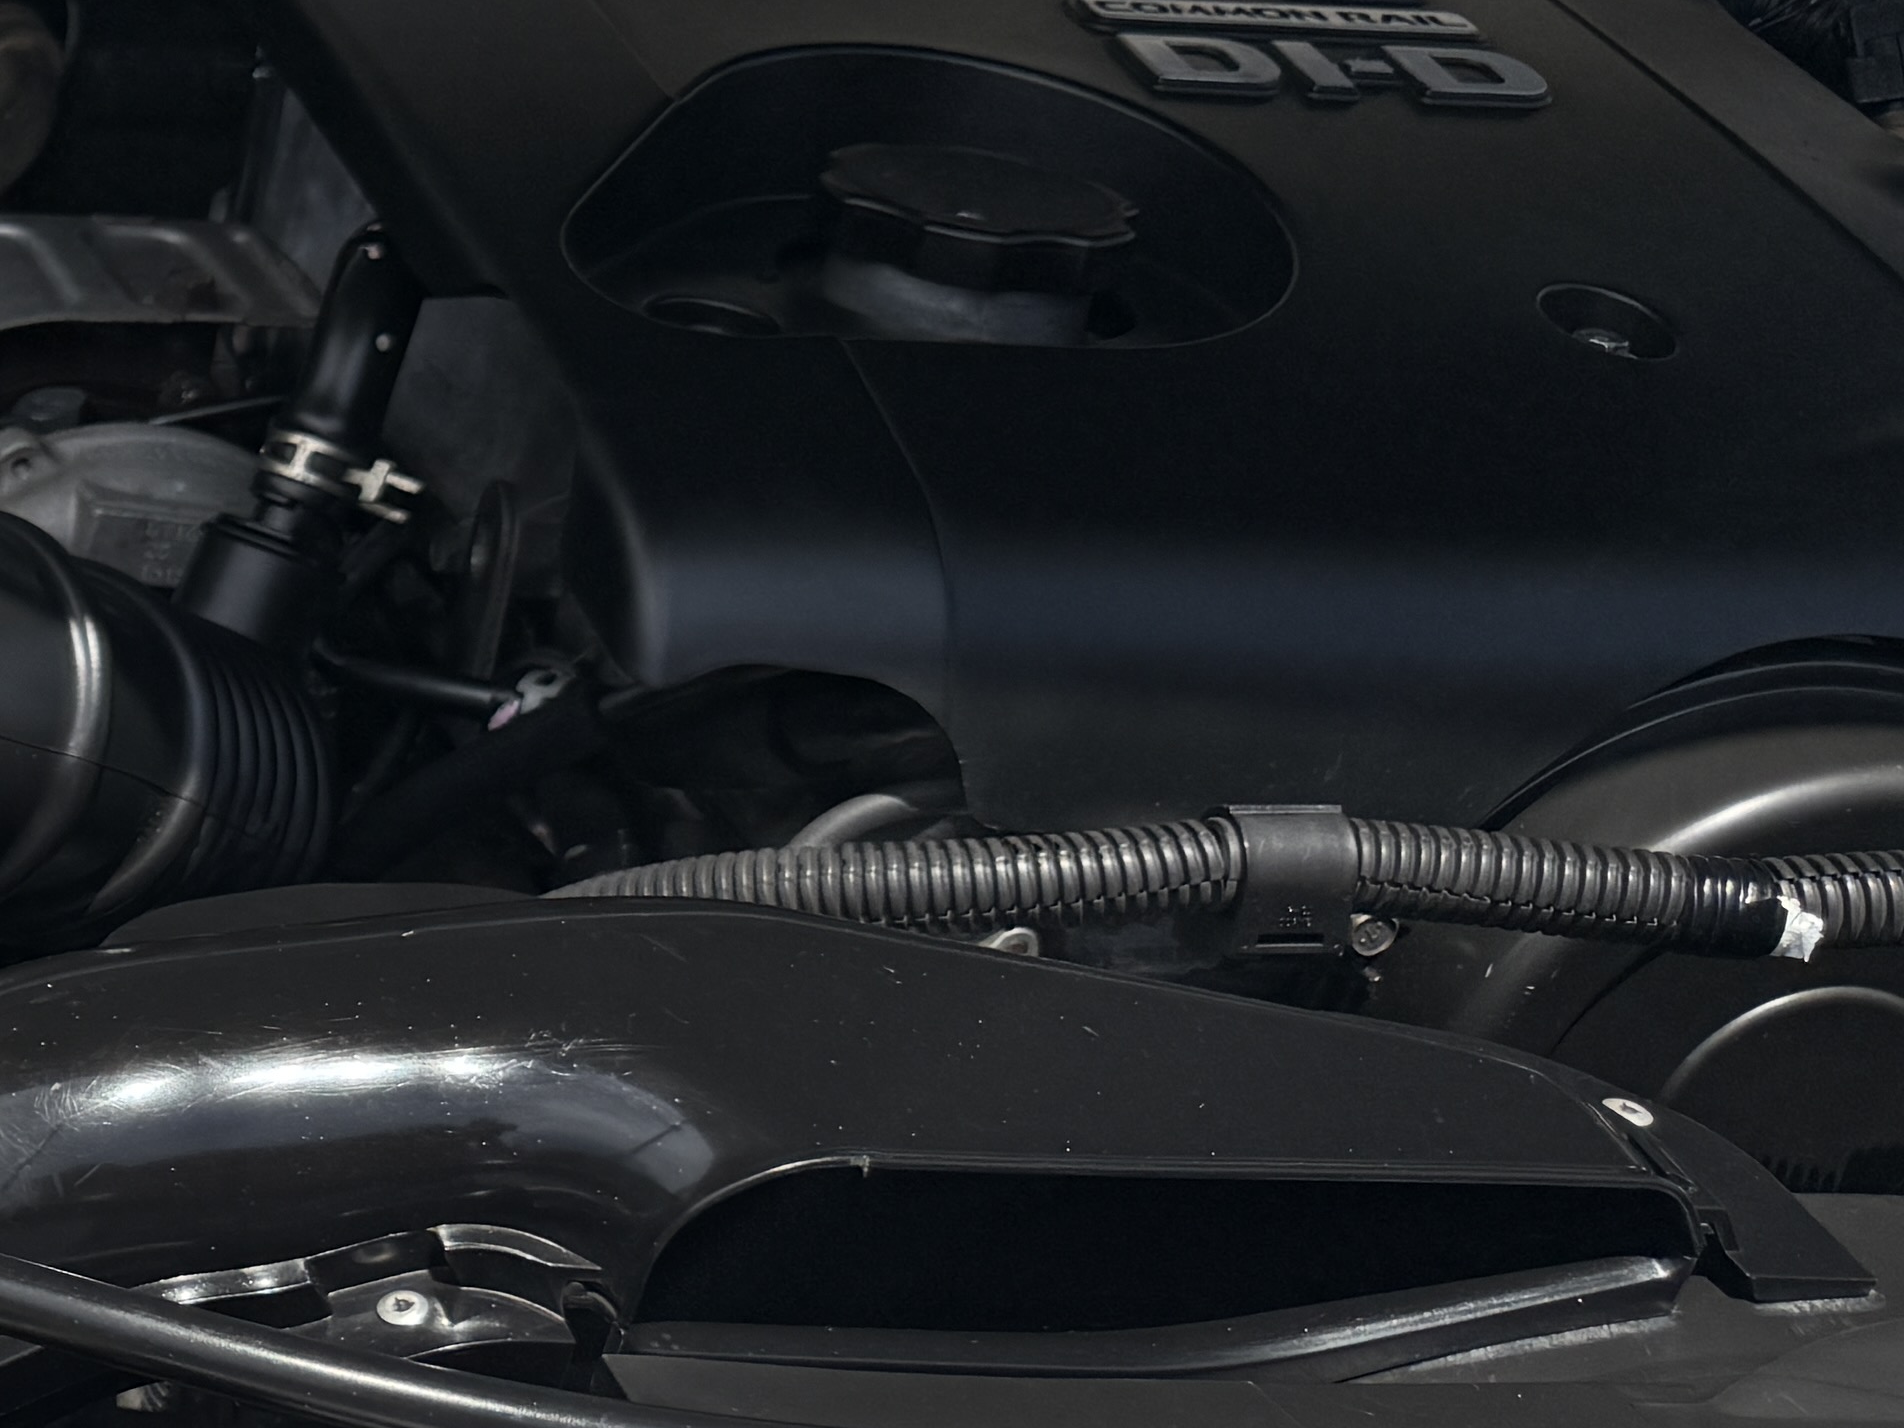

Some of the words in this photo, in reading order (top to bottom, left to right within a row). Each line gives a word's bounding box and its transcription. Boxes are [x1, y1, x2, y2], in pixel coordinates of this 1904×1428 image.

[1094, 0, 1329, 22] COMMON
[1339, 10, 1468, 28] RAIL
[1116, 33, 1550, 107] DI-D
